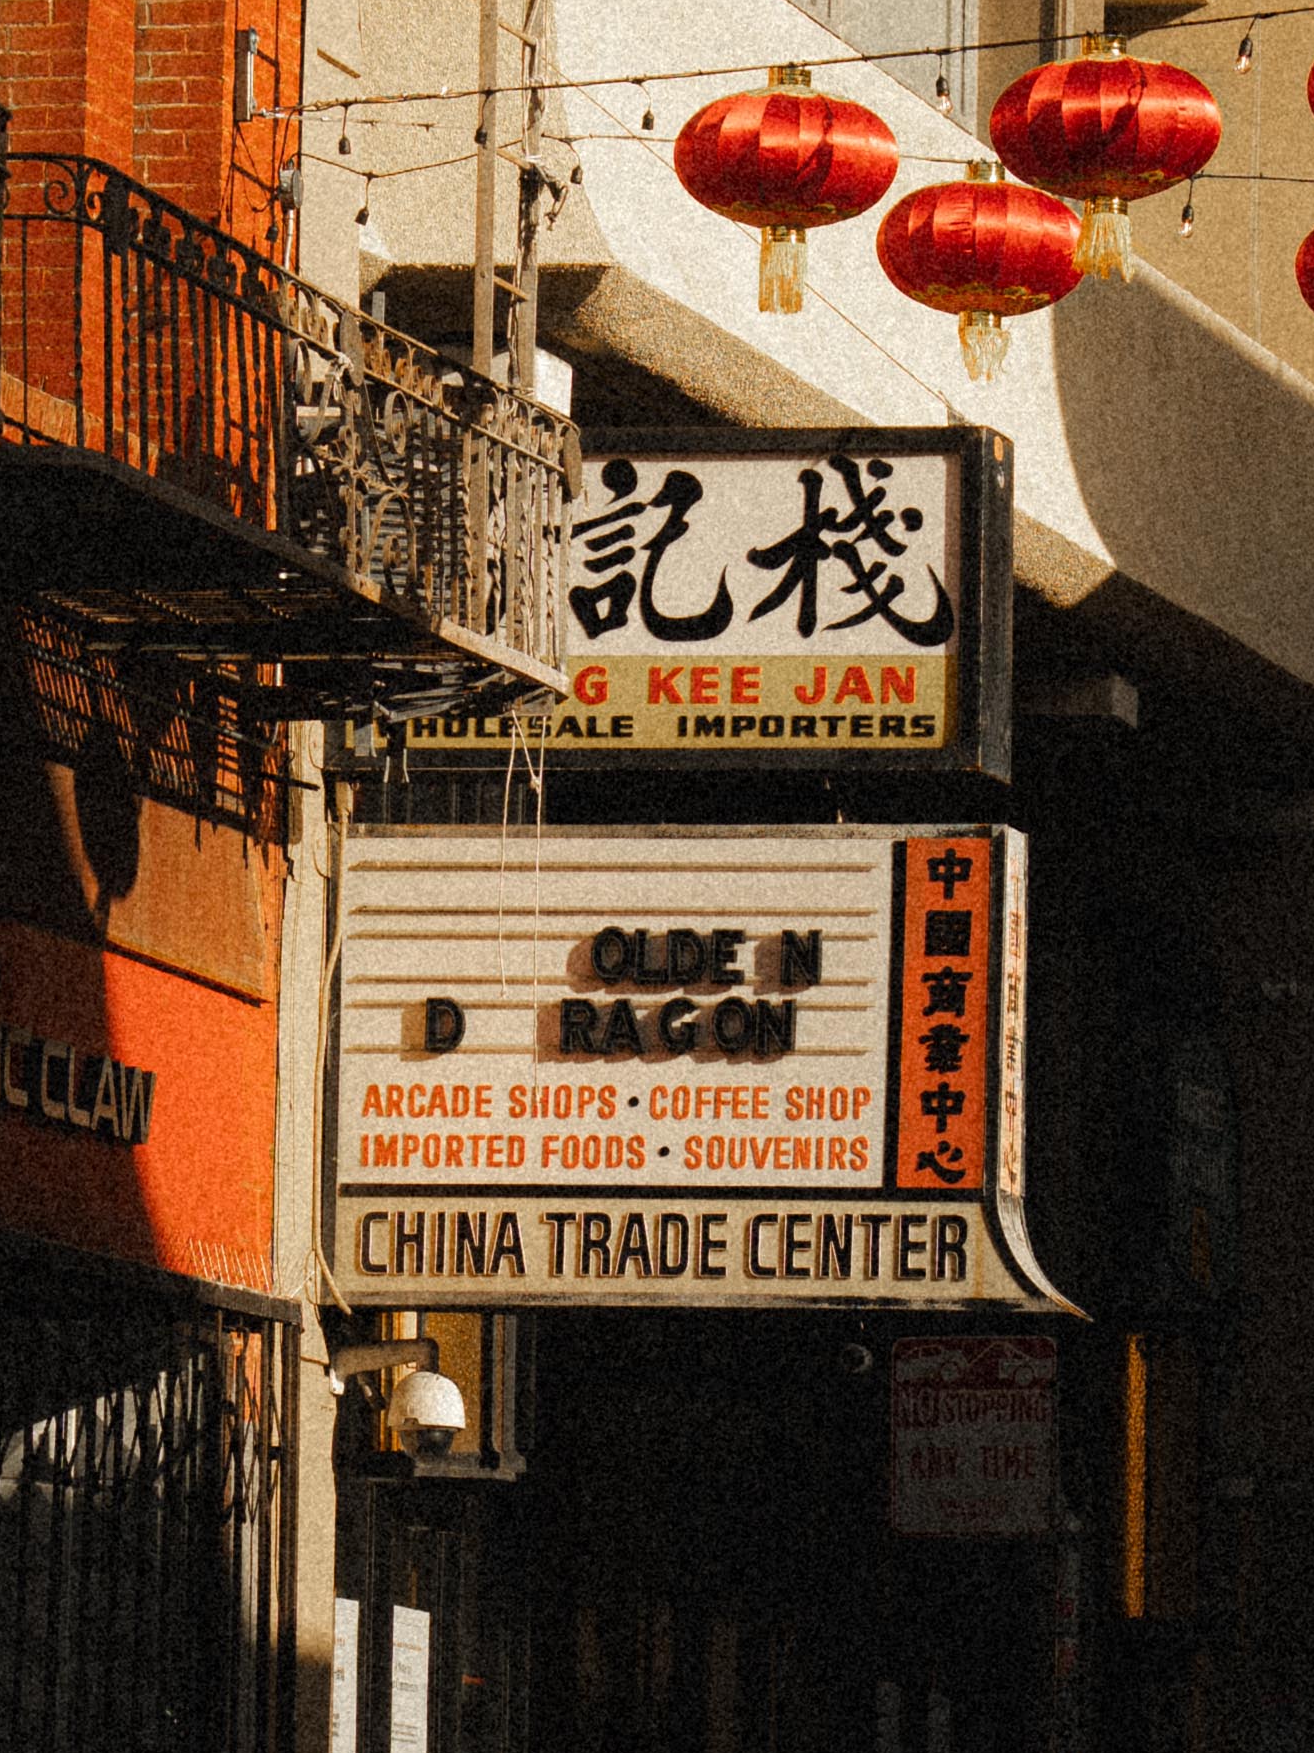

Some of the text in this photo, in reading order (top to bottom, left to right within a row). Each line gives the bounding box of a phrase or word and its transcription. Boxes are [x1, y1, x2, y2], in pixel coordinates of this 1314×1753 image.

[647, 665, 762, 705] KEE
[794, 665, 917, 706] JAN
[676, 713, 936, 739] IMPORTERS
[40, 1038, 157, 1145] CLAW
[361, 1083, 871, 1121] ARCADE SHOPS COFFEE SHOP
[360, 1133, 869, 1172] IMPORTED FOODS SOUVENIRS
[357, 1209, 970, 1283] CHINA TRADE CENTER
[942, 1390, 1050, 1423] STOPPING
[981, 1444, 1037, 1480] TIME
